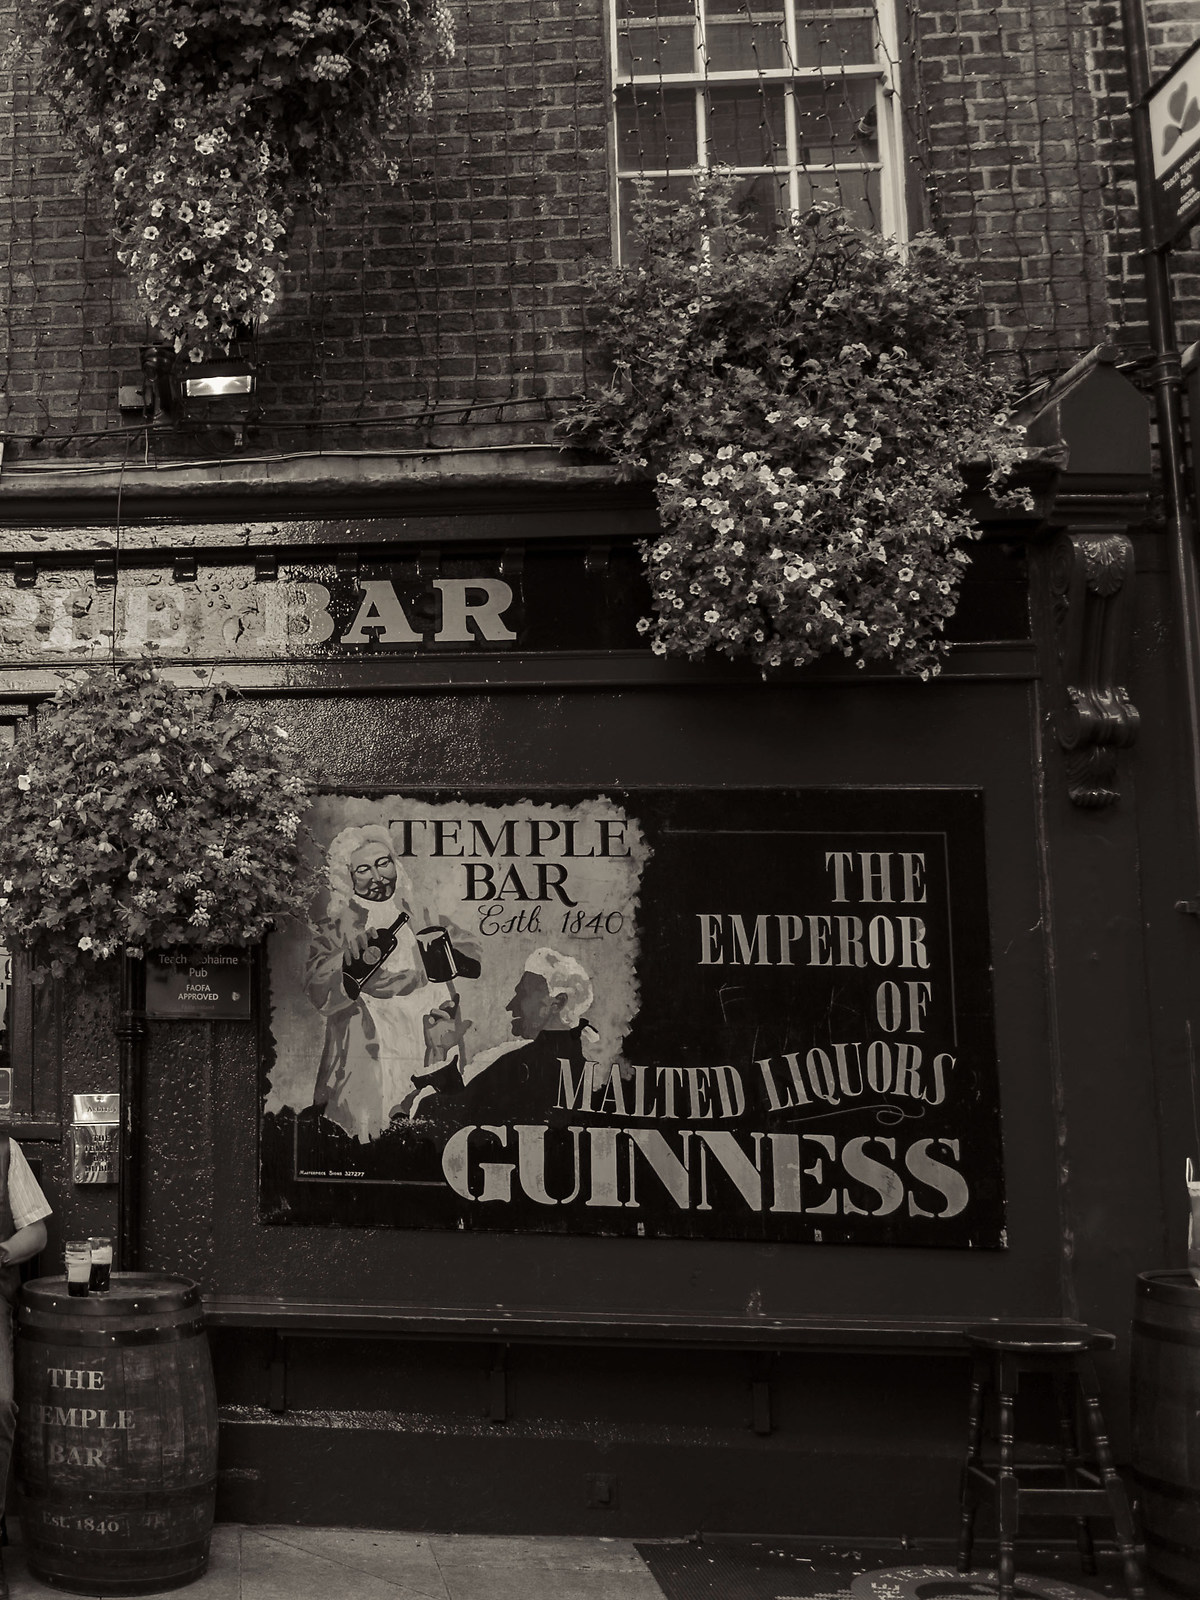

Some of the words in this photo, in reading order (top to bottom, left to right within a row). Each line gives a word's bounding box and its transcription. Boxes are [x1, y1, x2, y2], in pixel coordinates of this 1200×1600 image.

[257, 578, 517, 645] BAR
[388, 819, 633, 858] TEMPLE
[461, 862, 578, 906] BAR
[824, 851, 928, 904] THE
[561, 908, 626, 937] 1840
[696, 913, 932, 971] EMPEROR
[186, 984, 211, 992] FAOFA
[189, 967, 208, 978] Pub
[177, 993, 219, 1001] APPROVED
[874, 980, 933, 1034] OF
[553, 1056, 744, 1121] MALTED
[760, 1041, 958, 1113] LIQUORS
[441, 1124, 971, 1221] GUINNESS
[47, 1367, 105, 1391] THE
[49, 1441, 106, 1468] BAR
[76, 1518, 120, 1535] 1840
